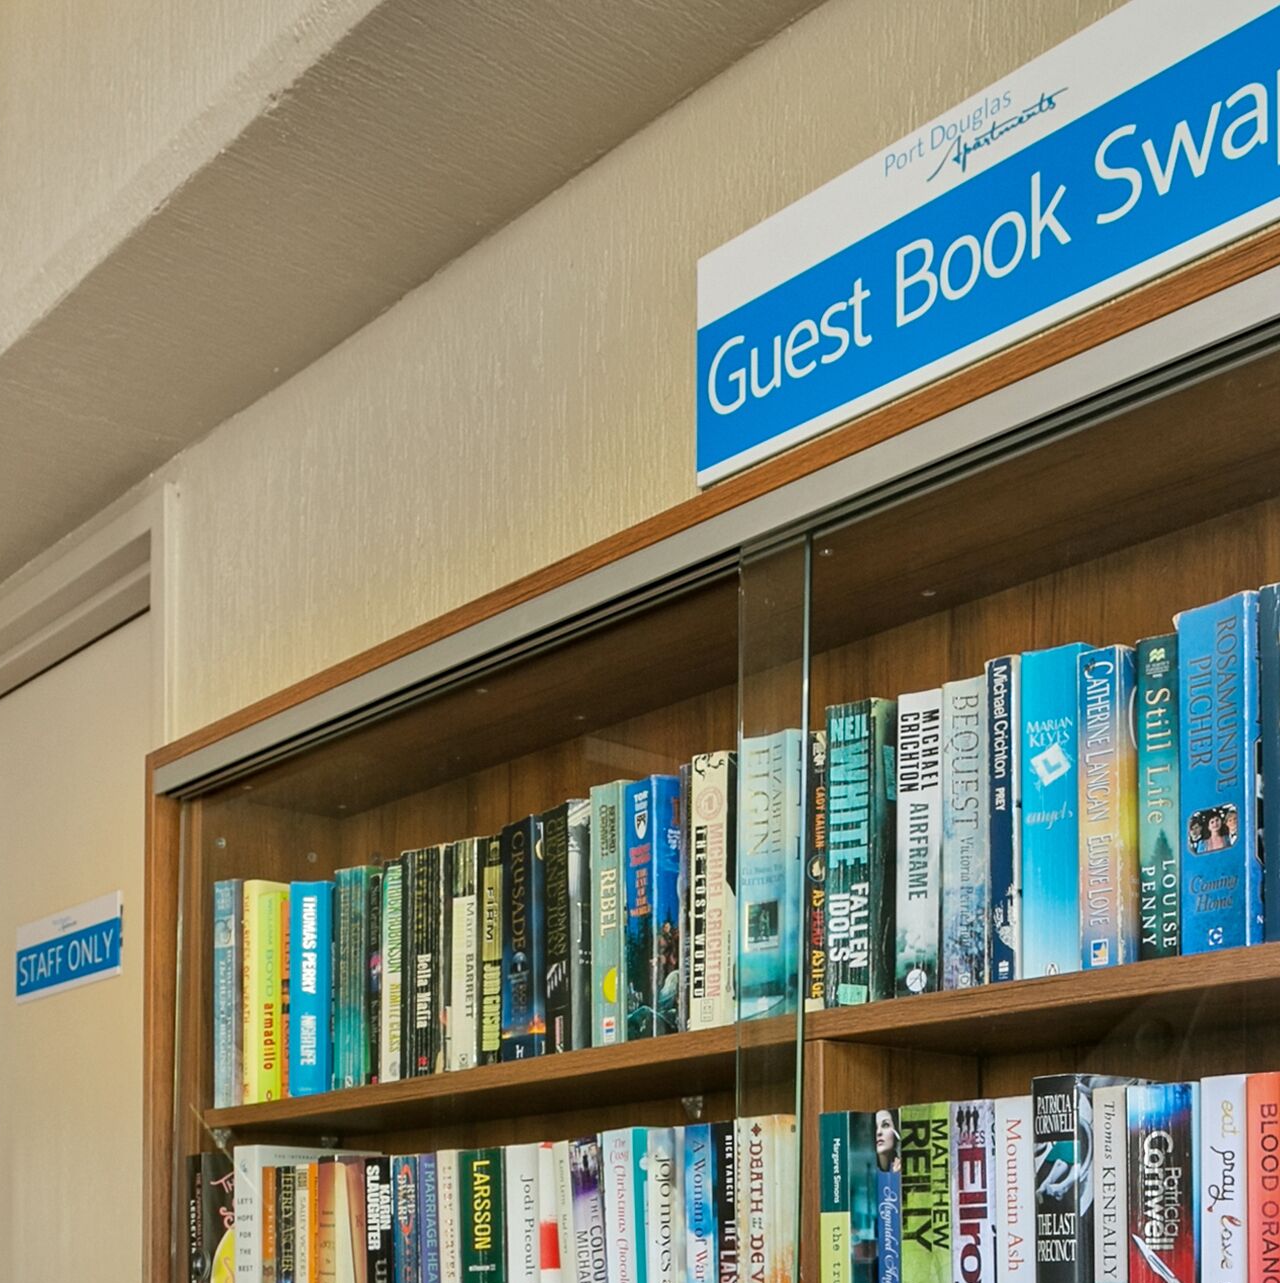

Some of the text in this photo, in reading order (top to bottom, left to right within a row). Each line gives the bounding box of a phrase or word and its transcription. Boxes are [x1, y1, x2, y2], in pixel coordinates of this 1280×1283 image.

[883, 89, 1012, 177] Port Douglas
[926, 87, 1070, 182] Apartments
[706, 276, 873, 415] Guest
[895, 171, 1072, 328] Book
[1189, 656, 1215, 769] PILCHER
[1216, 614, 1238, 793] ROSAMUNDE
[899, 711, 921, 794] CRICHTON
[920, 708, 939, 792] MICHAEL
[944, 694, 979, 830] BEQUEST
[1146, 687, 1172, 825] Still Life
[907, 803, 929, 901] AIRFRAME
[1189, 873, 1239, 893] Coming
[302, 895, 317, 994] THOMAS PERRY
[600, 868, 617, 937] REBEL
[707, 824, 723, 998] MICHAEL CRICHTON
[827, 892, 850, 962] IDOLS
[849, 880, 870, 969] FALLEN
[1141, 865, 1157, 946] PENNY
[1162, 859, 1177, 949] LOUISE
[19, 927, 114, 987] STAFF ONLY
[416, 952, 432, 988] Bella
[263, 1002, 276, 1071] armadillo
[415, 991, 432, 1029] Mafia
[748, 1139, 764, 1214] DEATH
[901, 1118, 933, 1253] REILLY
[930, 1118, 950, 1250] MATTHEW
[1141, 1129, 1174, 1251] Cornwell
[1259, 1102, 1280, 1192] BLOOD
[365, 1164, 380, 1252] SLAUGHTER
[379, 1183, 391, 1231] KARIN
[424, 1169, 438, 1249] MARRIAGE
[471, 1159, 492, 1250] LARSSON
[520, 1174, 536, 1277] Jodi Picoult
[1004, 1117, 1023, 1272] Mountain Ash
[1162, 1166, 1182, 1237] Patricia
[1036, 1238, 1077, 1264] PRECINCT
